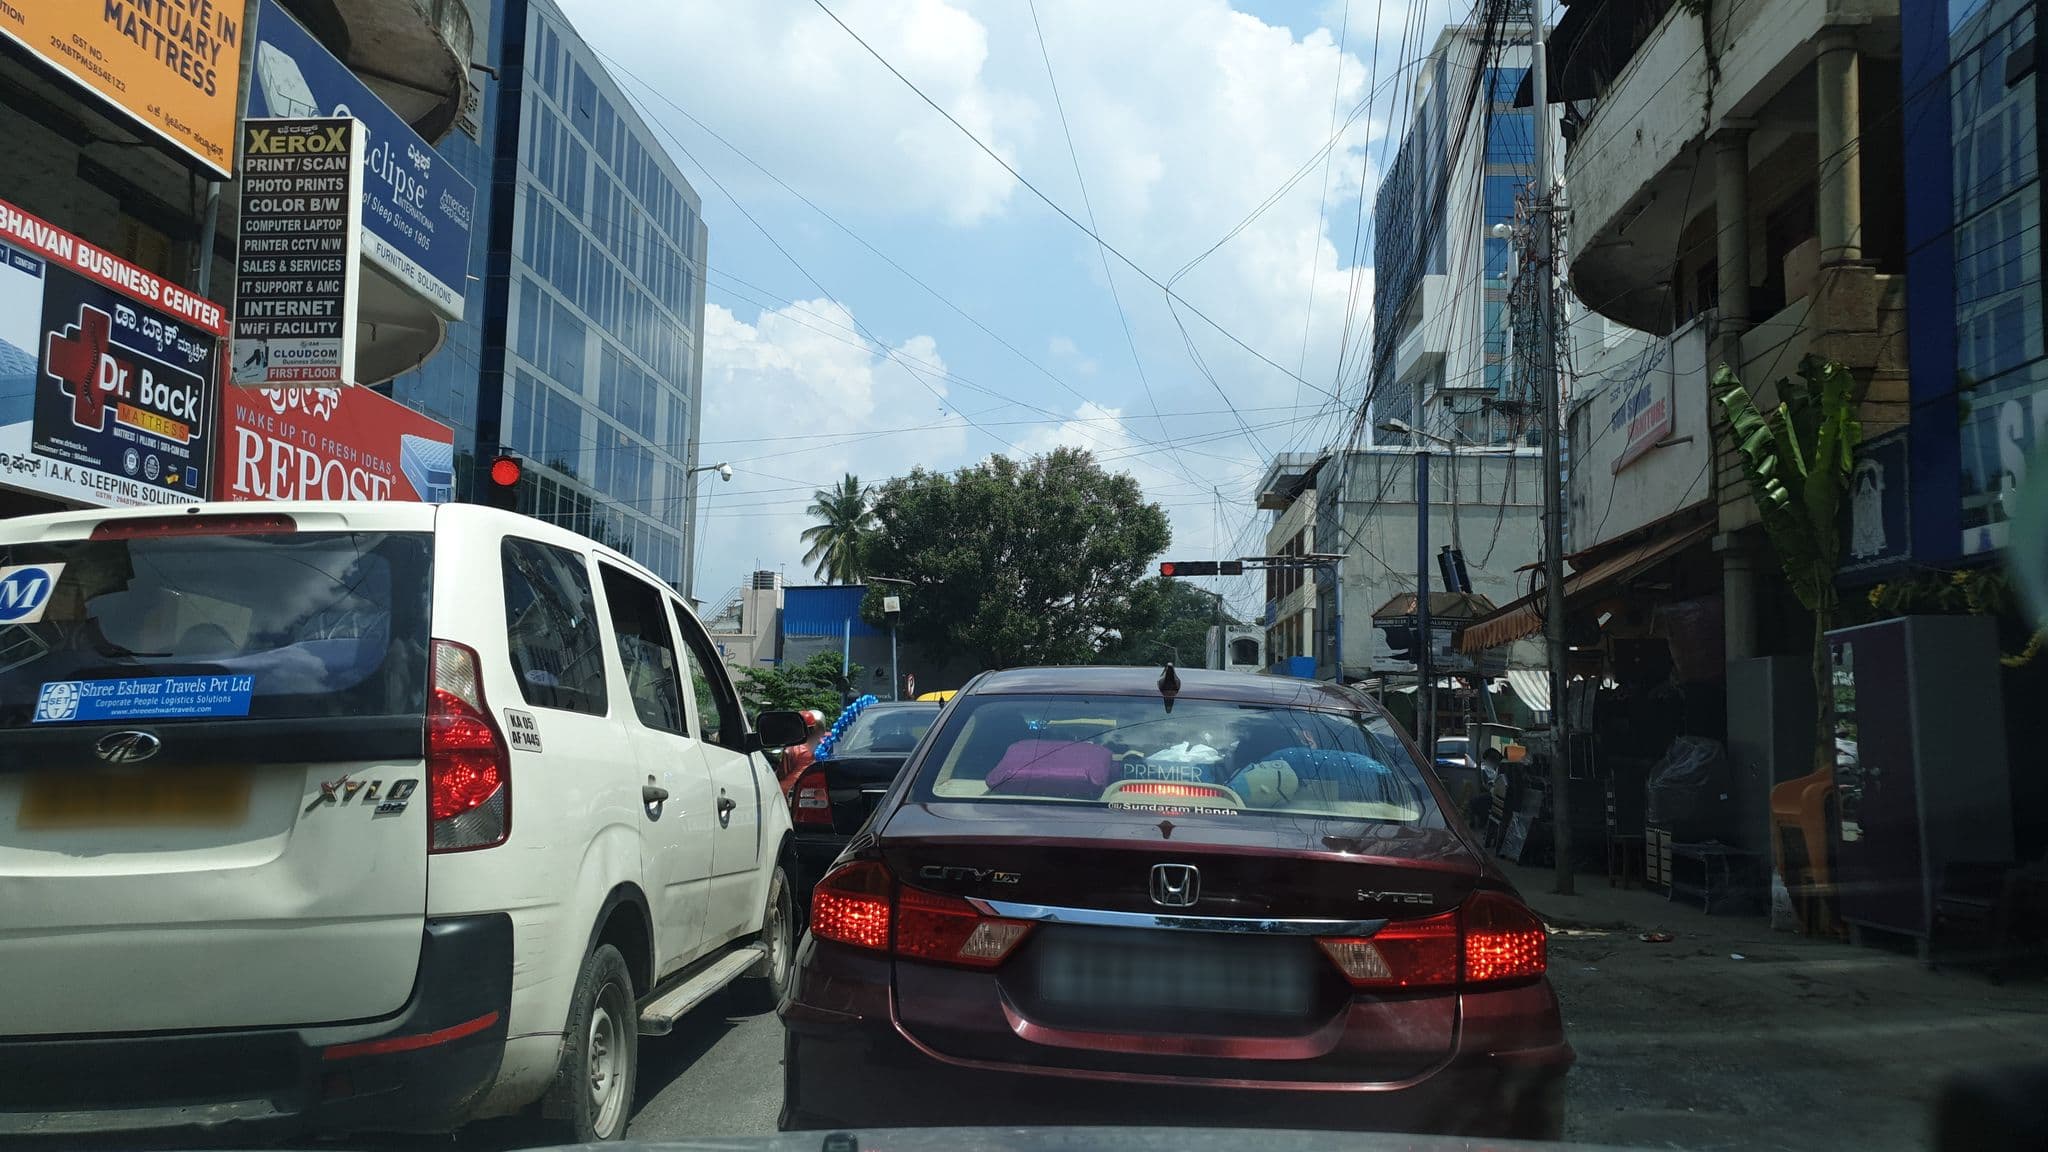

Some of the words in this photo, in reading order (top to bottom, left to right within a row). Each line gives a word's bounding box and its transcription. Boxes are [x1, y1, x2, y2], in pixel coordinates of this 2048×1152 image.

[126, 0, 222, 67] NTUARY
[217, 11, 237, 49] IN
[72, 33, 88, 49] GST
[89, 46, 103, 61] NO
[103, 0, 217, 98] MATTRESS
[247, 179, 292, 192] PHOTO
[295, 178, 344, 191] PRINTS
[249, 199, 305, 212] COLOR
[310, 198, 340, 211] B/W
[246, 220, 301, 232] COMPUTER
[303, 219, 342, 231] LAPTOP
[371, 196, 393, 224] Sleep
[393, 213, 413, 238] Since
[414, 230, 431, 251] 1905
[244, 239, 289, 252] PRINTER
[291, 239, 319, 251] CCTV
[321, 238, 342, 250] N/W
[242, 260, 276, 272] SALES
[279, 260, 287, 272] &
[290, 259, 342, 271] SERVICES
[376, 242, 415, 279] FURNITURE
[417, 272, 452, 305] SOLUTIONS
[77, 243, 160, 301] BUSINESS
[163, 286, 220, 330] CENTER
[241, 281, 252, 293] IT
[255, 281, 303, 293] SUPPORT
[305, 280, 314, 292] &
[316, 280, 339, 292] AMC
[244, 300, 336, 316] INTERNET
[240, 322, 270, 335] WiFi
[274, 321, 338, 334] FACILITY
[273, 349, 338, 358] CLOUDCOM
[269, 368, 300, 379] FIRST
[302, 367, 337, 379] FLOOR
[99, 352, 131, 399] Dr.
[140, 367, 198, 423] Back
[121, 407, 186, 439] MATTRESS
[236, 404, 275, 433] WAKE
[280, 421, 296, 439] UP
[302, 430, 316, 448] TO
[321, 437, 358, 461] FRESH
[361, 453, 392, 476] IDEAS
[50, 462, 76, 484] A.K.
[80, 470, 138, 498] SLEEPING
[81, 682, 115, 697] Shree
[117, 680, 162, 696] Eshwar
[165, 678, 206, 693] Travels
[208, 678, 228, 692] Pvt
[230, 676, 250, 692] Ltd
[95, 698, 131, 708] Corporate
[134, 697, 158, 707] People
[161, 695, 195, 706] Logistics
[197, 694, 231, 704] Solutions
[509, 713, 523, 729] KA
[521, 715, 533, 730] 05
[511, 730, 521, 744] AF
[522, 732, 541, 747] 1445
[1122, 762, 1203, 783] PREMIER
[304, 774, 419, 813] XYLO
[1122, 802, 1190, 814] Sundaram
[1194, 804, 1238, 816] Honda
